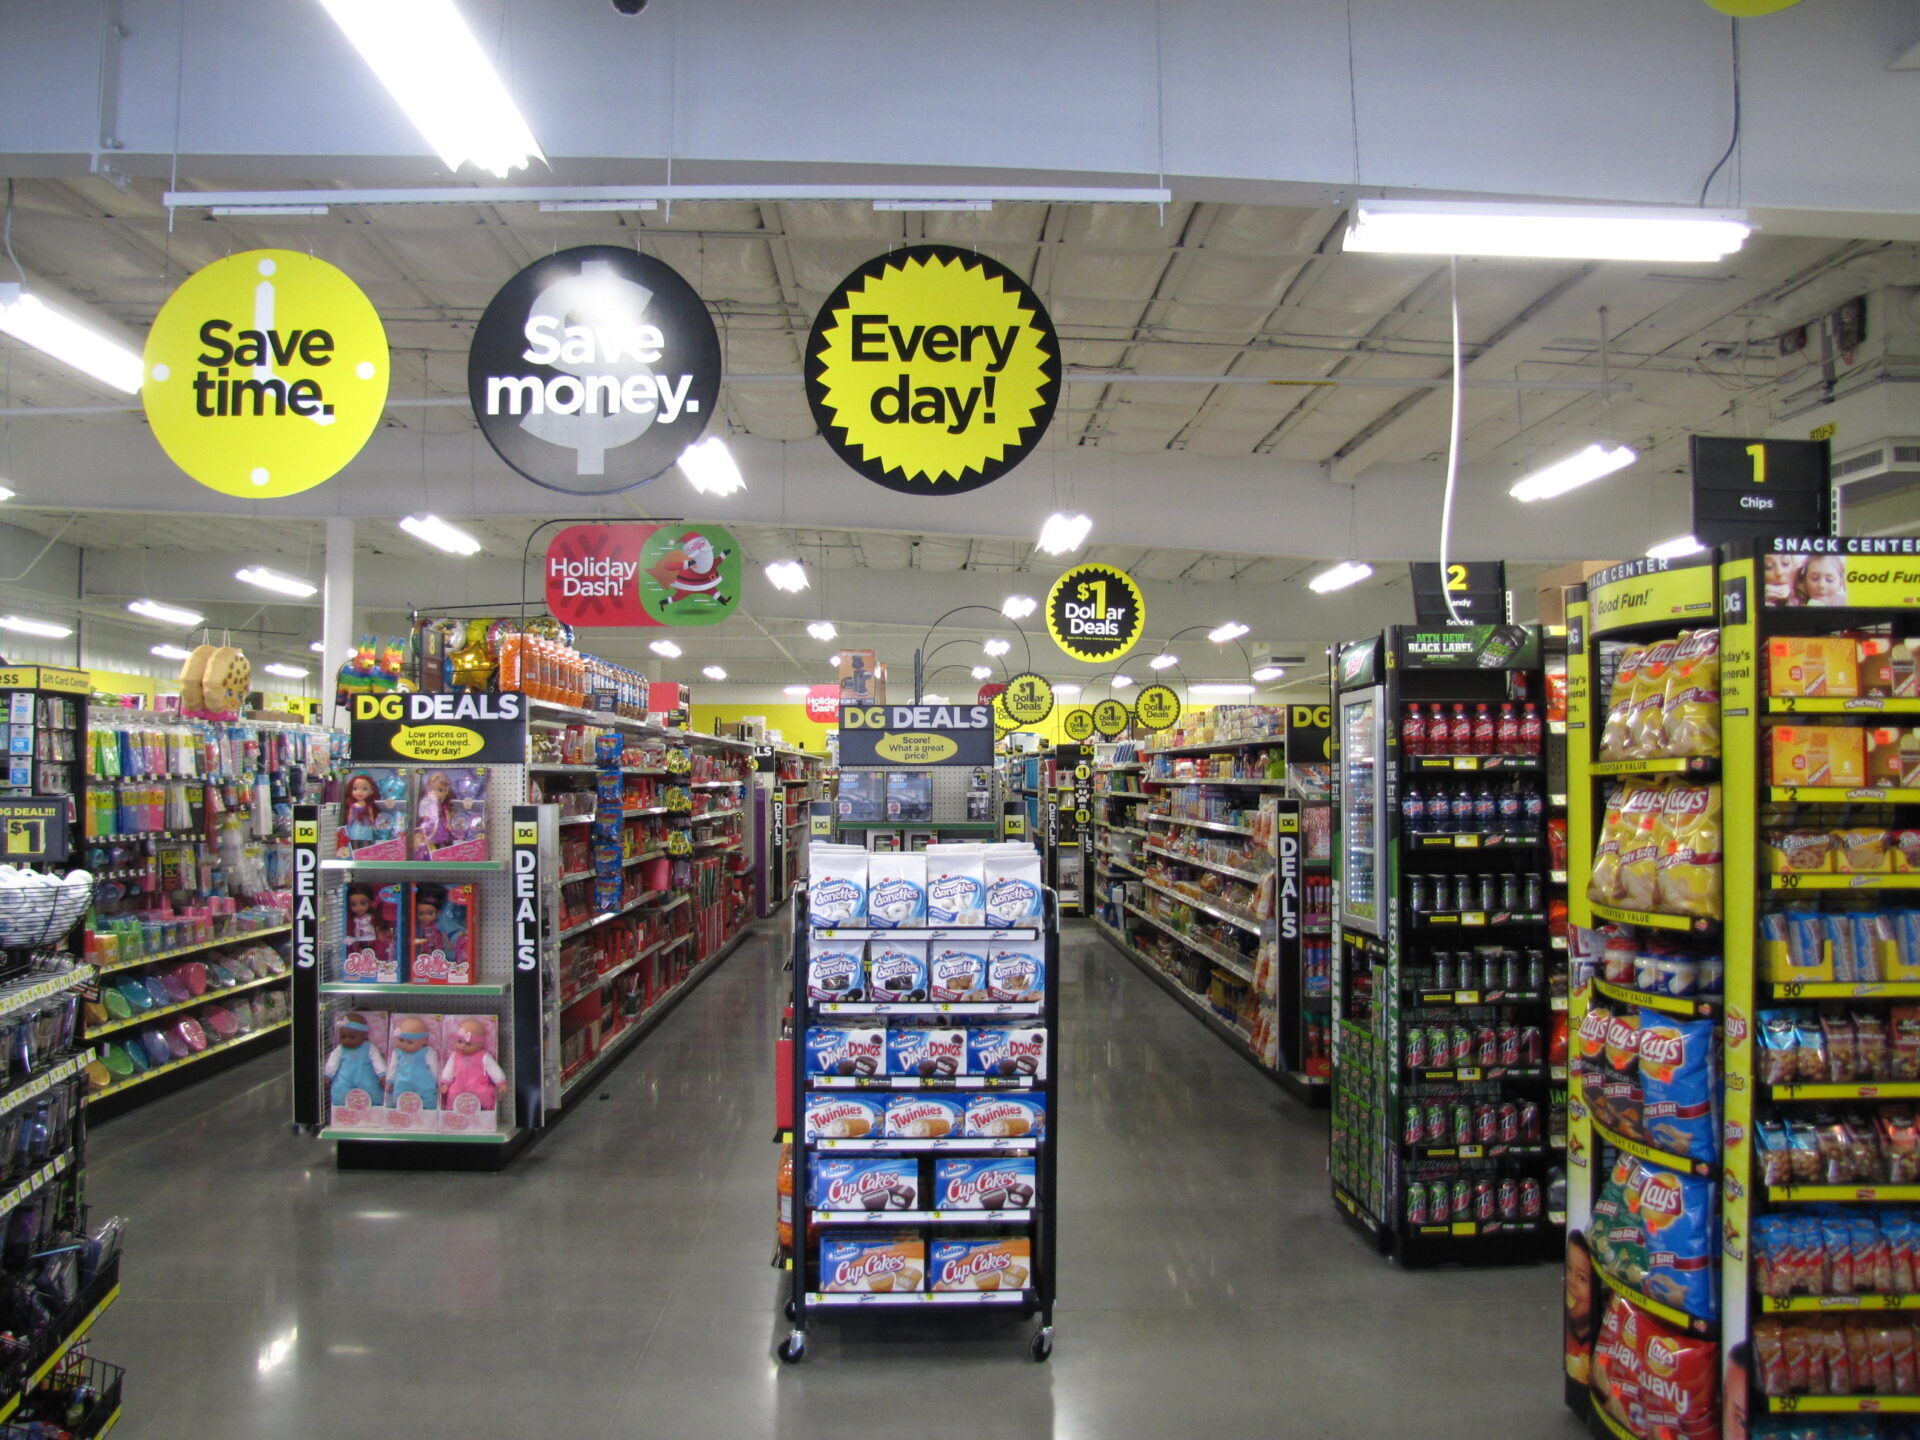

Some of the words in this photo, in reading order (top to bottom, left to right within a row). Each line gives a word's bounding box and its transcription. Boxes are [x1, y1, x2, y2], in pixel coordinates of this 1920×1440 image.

[199, 320, 334, 367] Save
[523, 316, 664, 365] Save
[850, 314, 1020, 373] Every
[193, 370, 334, 417] time.
[486, 373, 699, 423] money.
[870, 374, 996, 434] day!
[1746, 444, 1764, 482] 1
[1740, 497, 1773, 510] Chips
[1774, 538, 1838, 552] SNACK
[551, 557, 637, 581] Holiday
[1447, 565, 1467, 590] 2
[1611, 558, 1668, 581] CENTER
[1847, 571, 1889, 583] Good
[563, 577, 624, 597] Dash!
[1077, 580, 1106, 619] $1
[1450, 599, 1472, 607] andy
[1598, 595, 1619, 615] Good
[1621, 589, 1649, 609] Fun!
[1724, 593, 1740, 612] DG
[1071, 618, 1119, 635] Deals
[1408, 643, 1440, 653] BLACK
[1443, 643, 1473, 653] LABEL
[1416, 634, 1441, 643] MTN
[1442, 634, 1465, 643] DEW
[1721, 651, 1750, 663] oday's
[55, 675, 69, 686] Card
[356, 694, 403, 720] DG
[411, 694, 520, 720] DEALS
[807, 697, 839, 706] Holiday
[1016, 702, 1041, 711] Deals
[844, 707, 886, 729] DG
[893, 707, 988, 729] DEALS
[1147, 710, 1168, 718] Deals
[1293, 706, 1330, 728] DG
[429, 731, 453, 740] prices
[903, 736, 930, 744] Score!
[414, 748, 439, 756] Every
[441, 747, 461, 756] day!
[889, 744, 913, 752] What
[922, 745, 944, 754] great
[904, 751, 929, 760] price!
[1625, 762, 1647, 770] VALUE
[11, 821, 41, 852] $1
[815, 887, 860, 906] donettes
[875, 887, 919, 907] donettes
[934, 882, 977, 899] donettes
[991, 887, 1035, 906] donettes
[1280, 837, 1298, 938] DEALS
[296, 849, 316, 969] DEALS
[515, 850, 536, 970] DEALS
[1628, 913, 1650, 923] VALUE
[1389, 896, 1398, 1008] FLAVORS
[814, 961, 857, 979] donettes
[877, 961, 919, 980] donettes
[939, 961, 982, 979] donettes
[994, 961, 1037, 980] donettes
[1389, 1015, 1398, 1073] NEW
[817, 1045, 848, 1071] DING
[848, 1042, 881, 1057] DONGS
[898, 1045, 928, 1071] DING
[929, 1041, 962, 1057] DONGS
[979, 1044, 1009, 1070] DING
[1009, 1041, 1042, 1057] DONGS
[811, 1106, 862, 1129] Twinkies
[891, 1106, 942, 1129] Twinkies
[971, 1106, 1022, 1129] Twinkies
[829, 1178, 857, 1204] Cup
[858, 1171, 899, 1195] Cakes
[947, 1178, 975, 1203] Cup
[976, 1171, 1017, 1194] Cakes
[835, 1261, 864, 1285] Cup
[864, 1253, 905, 1276] Cakes
[942, 1260, 971, 1284] Cup
[971, 1253, 1011, 1275] Cakes
